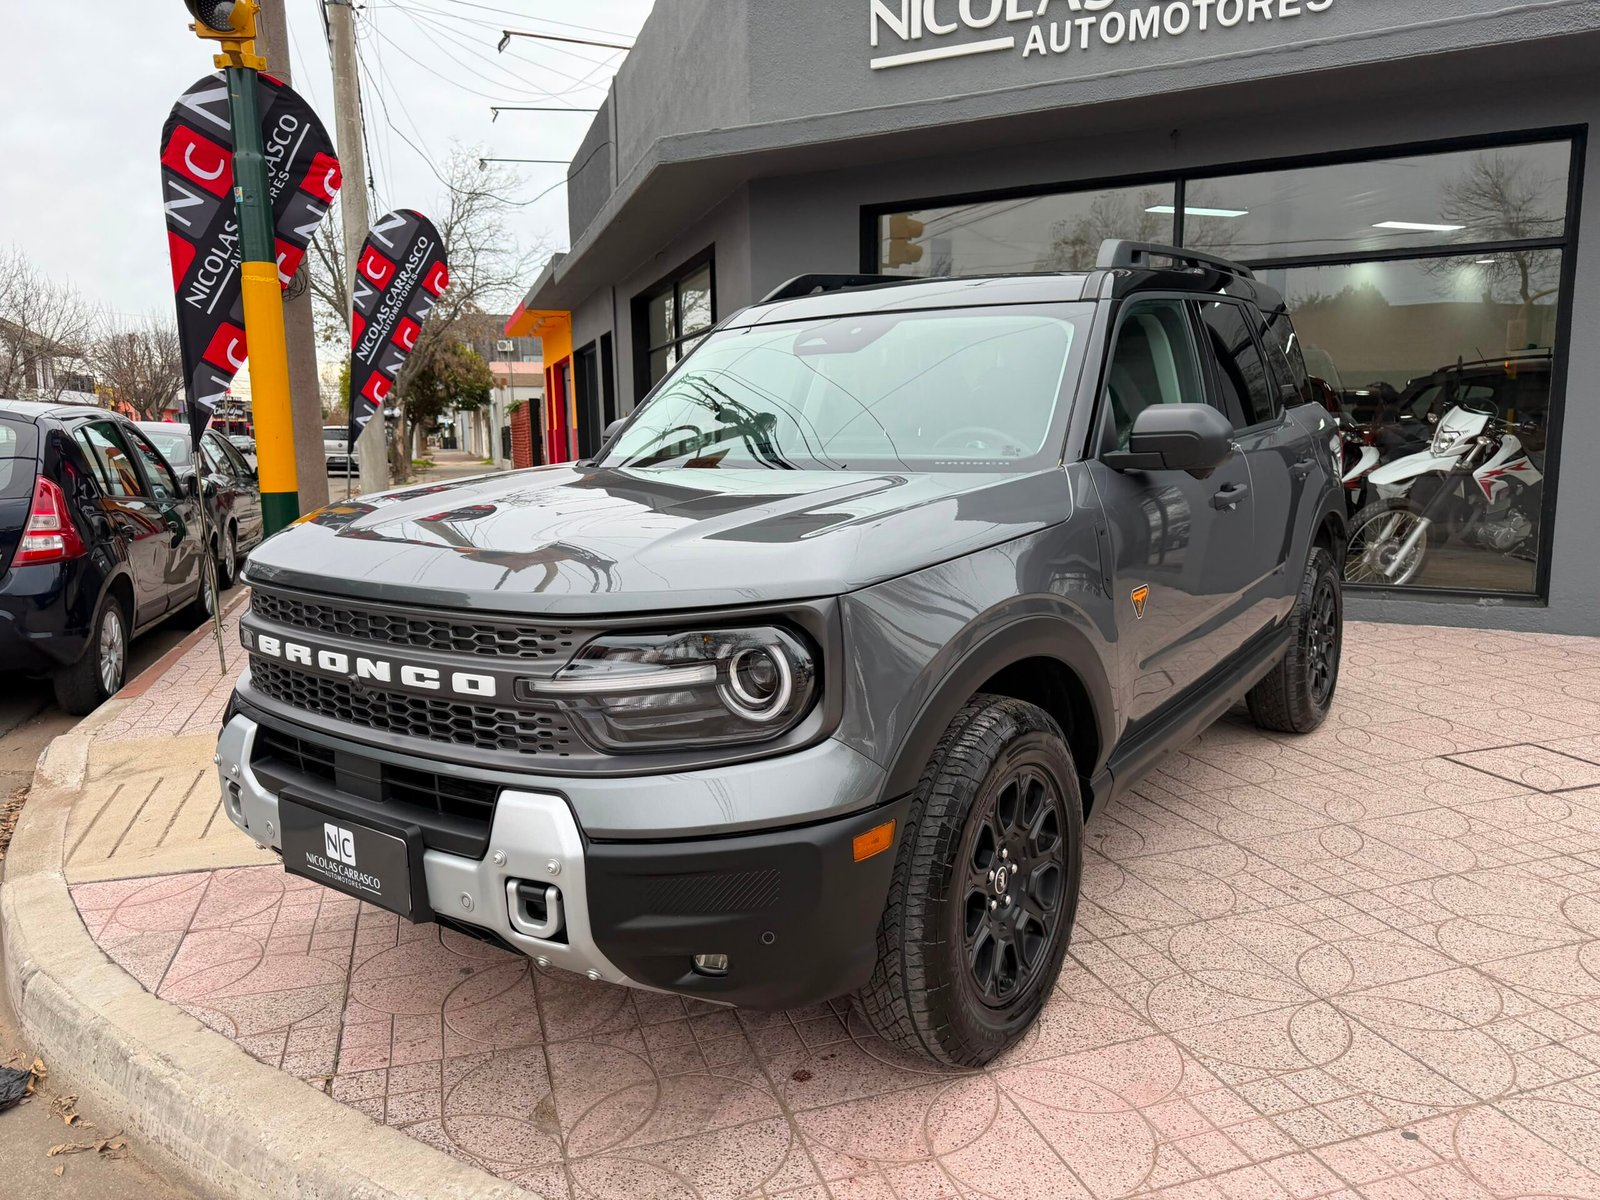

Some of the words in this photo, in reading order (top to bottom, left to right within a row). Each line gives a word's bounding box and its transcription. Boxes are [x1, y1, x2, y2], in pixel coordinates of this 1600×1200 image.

[185, 220, 239, 309] NICOLAS
[356, 305, 390, 361] NICOLAS
[385, 236, 428, 305] CARRASCO
[381, 273, 418, 337] AUTOMOTORES
[258, 634, 497, 697] BRONCO
[306, 852, 338, 873] NICOLAS
[338, 864, 381, 889] CARRASCO
[325, 870, 362, 890] AUTOMOTORES
